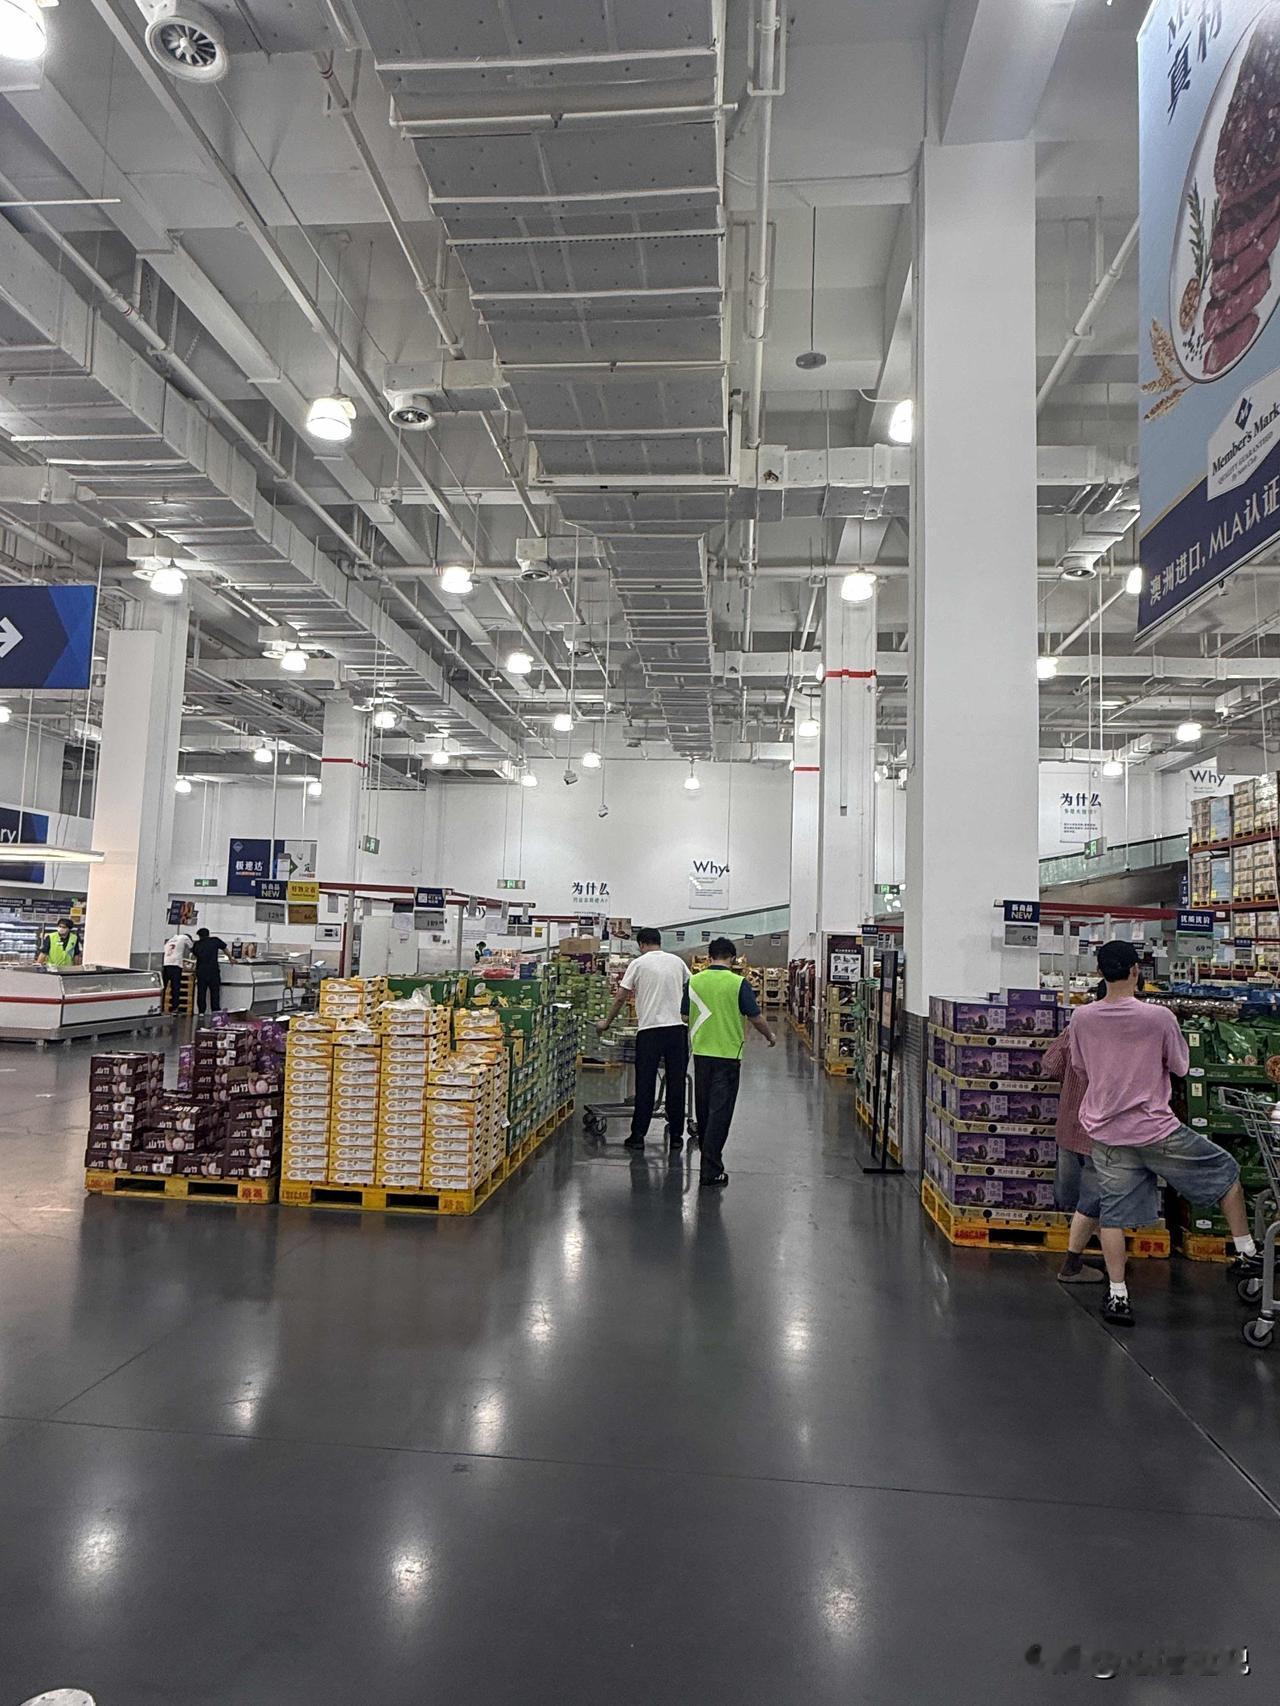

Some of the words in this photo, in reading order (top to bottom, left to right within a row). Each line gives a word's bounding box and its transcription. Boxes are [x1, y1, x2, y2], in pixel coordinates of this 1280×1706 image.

[1211, 430, 1253, 477] Member's
[1190, 769, 1226, 787] Why
[1060, 792, 1102, 807] 为什么
[693, 860, 728, 878] Why
[261, 890, 280, 898] NEW
[572, 881, 610, 896] 为什么
[1011, 911, 1033, 920] NEW
